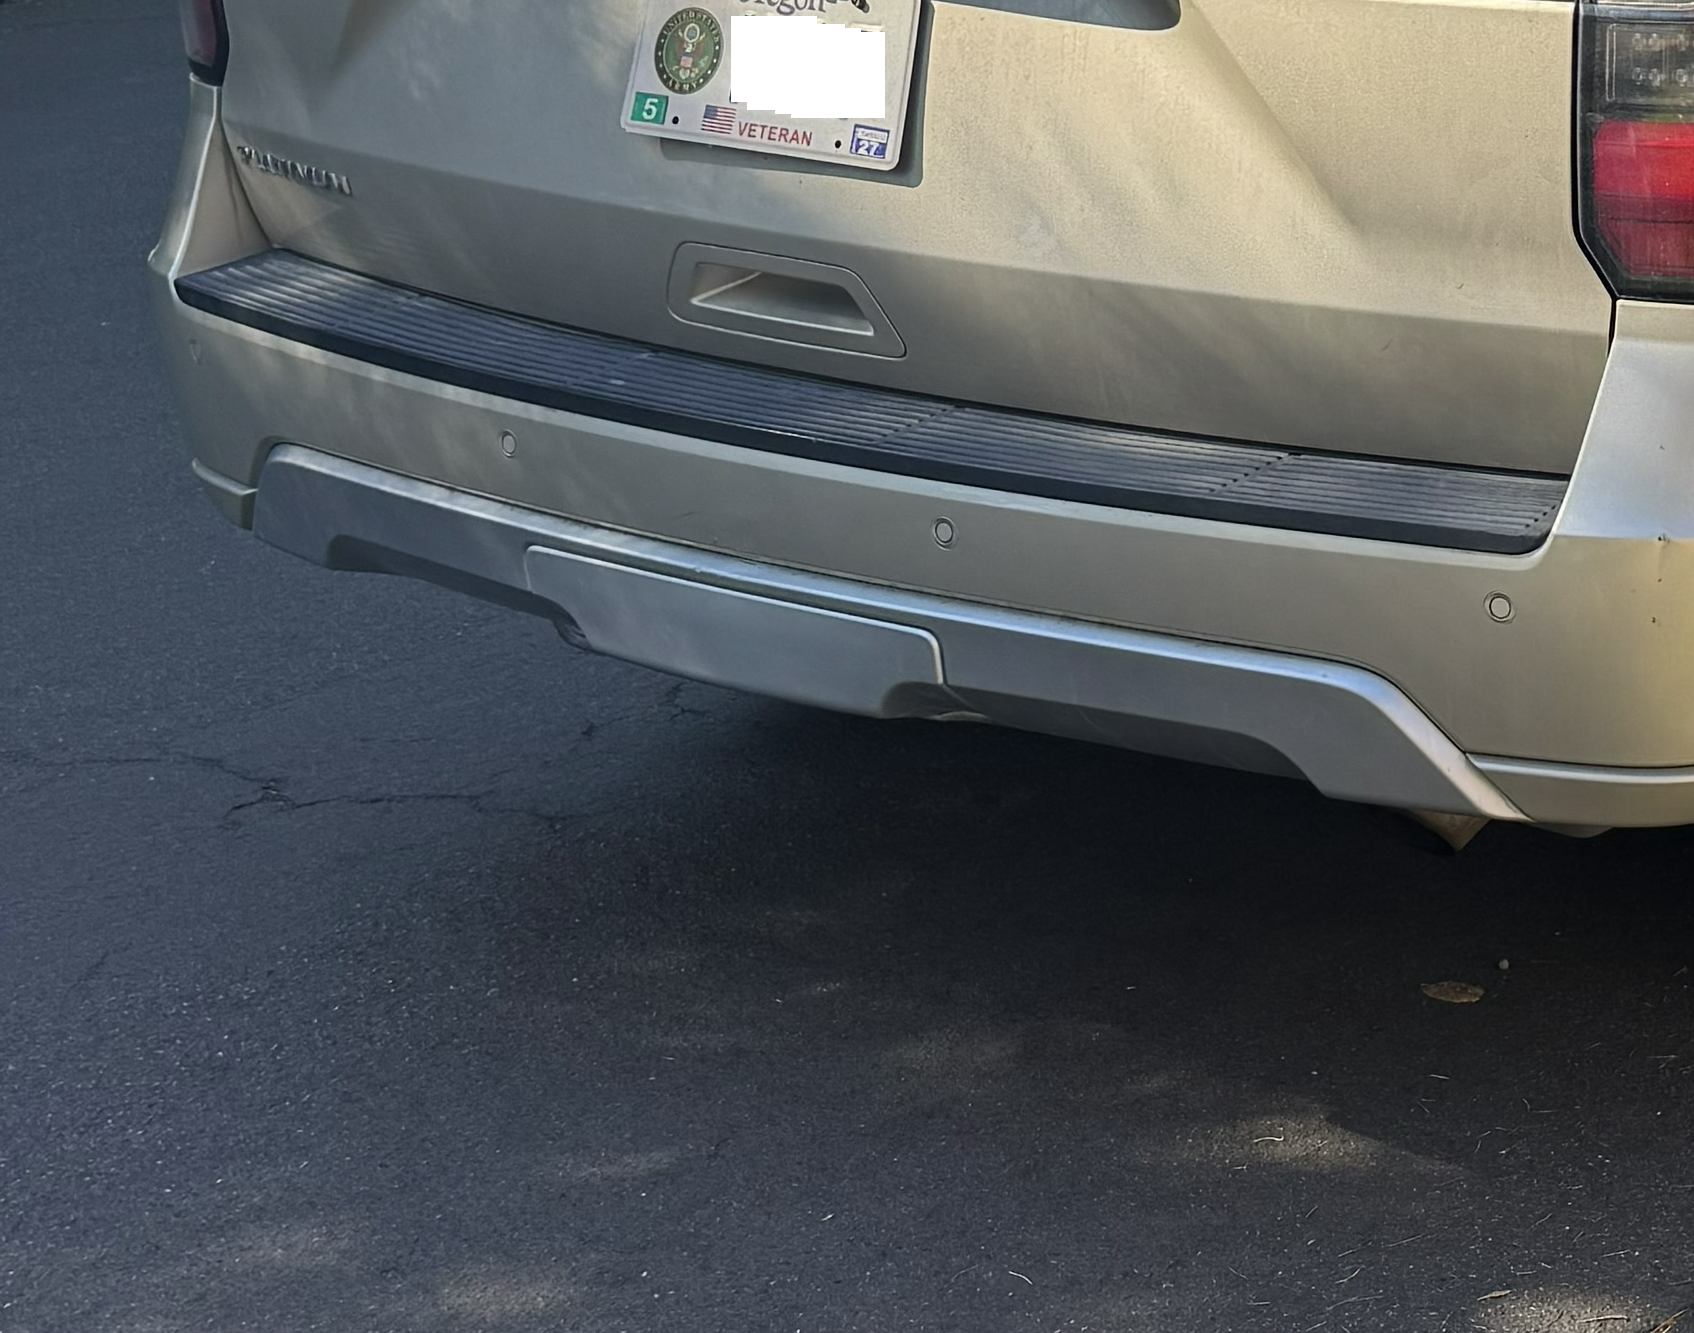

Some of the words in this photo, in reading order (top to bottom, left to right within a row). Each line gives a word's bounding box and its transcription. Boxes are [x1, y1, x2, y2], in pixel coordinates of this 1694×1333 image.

[641, 97, 659, 120] 5
[736, 122, 813, 147] VETERAN
[857, 140, 880, 156] 27
